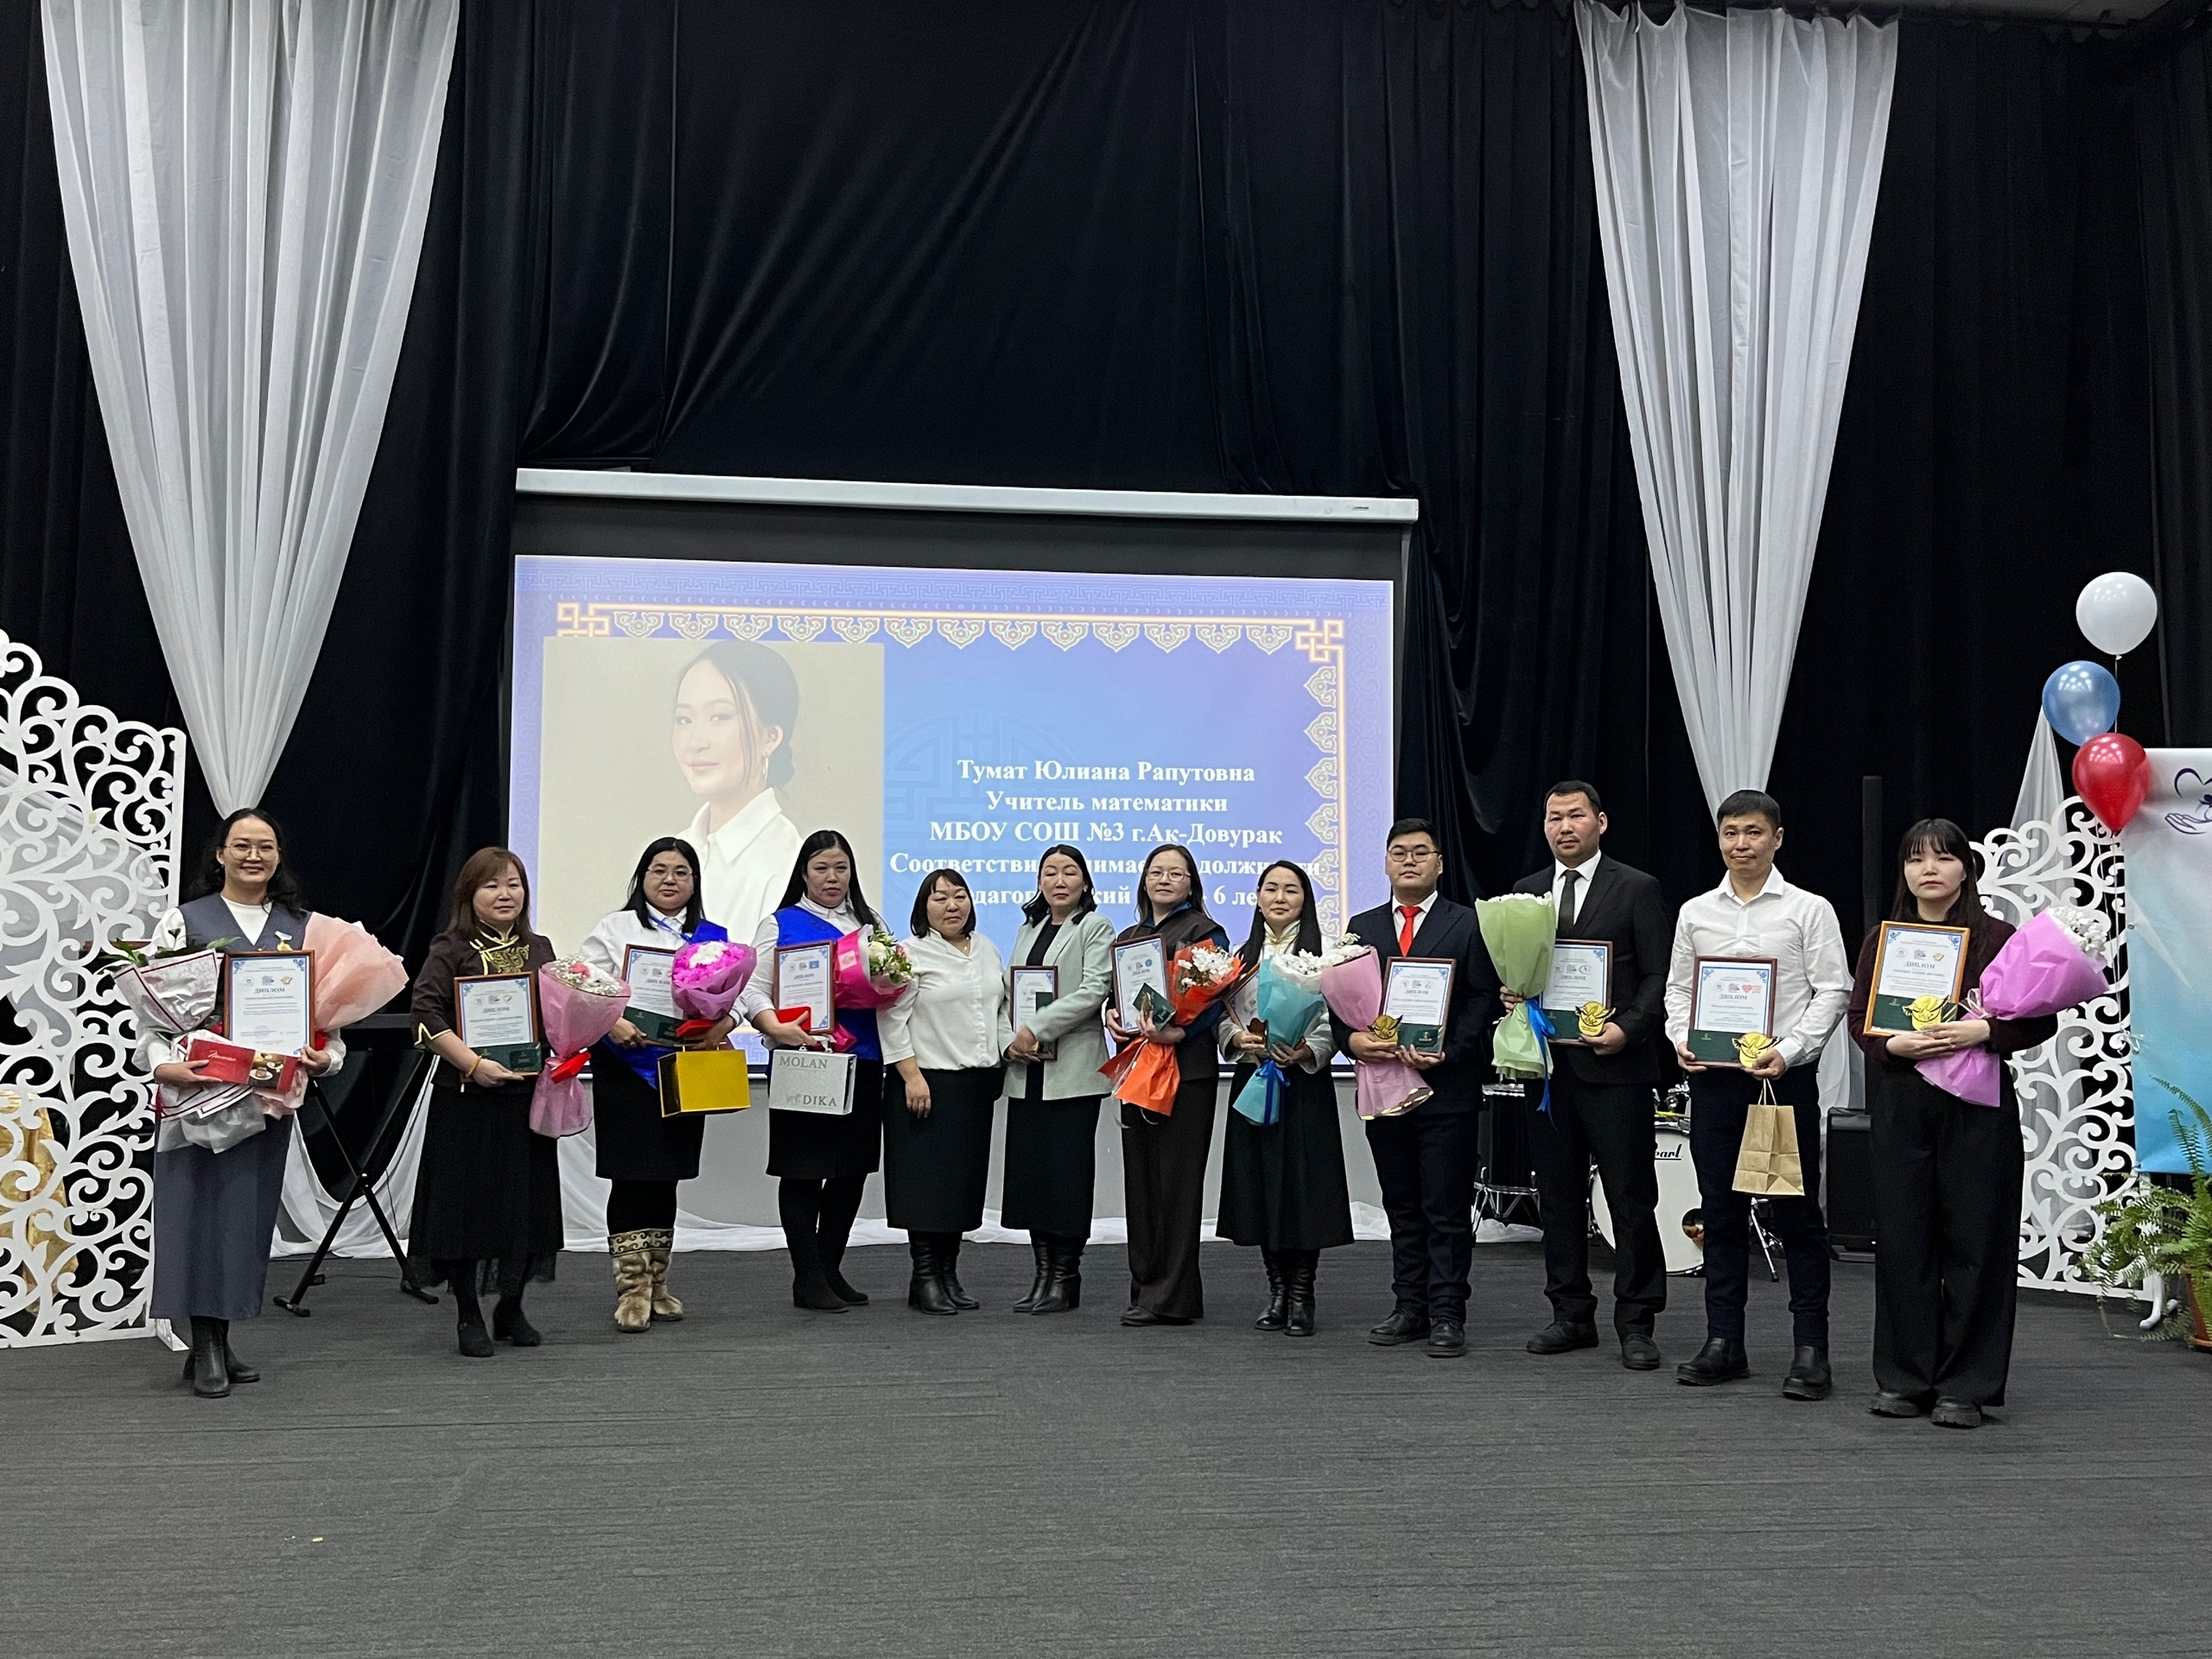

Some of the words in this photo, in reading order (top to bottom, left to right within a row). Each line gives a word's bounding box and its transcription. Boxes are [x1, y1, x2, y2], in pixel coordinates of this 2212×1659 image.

[957, 759, 1028, 785] Тумат
[1034, 760, 1130, 781] Юлиана
[1137, 761, 1255, 785] Рапутовна
[986, 790, 1085, 810] Учитель
[1091, 797, 1228, 812] математики
[929, 820, 1008, 842] МБОУ
[1014, 822, 1079, 842] СОШ
[1086, 822, 1124, 842] №3
[1131, 823, 1283, 848] г.Ак-Довурак
[889, 852, 1038, 873] Соответстви
[1199, 860, 1320, 876] должнти
[1213, 886, 1226, 905] 6
[1231, 892, 1258, 906] ле
[779, 1056, 829, 1070] MOLAN
